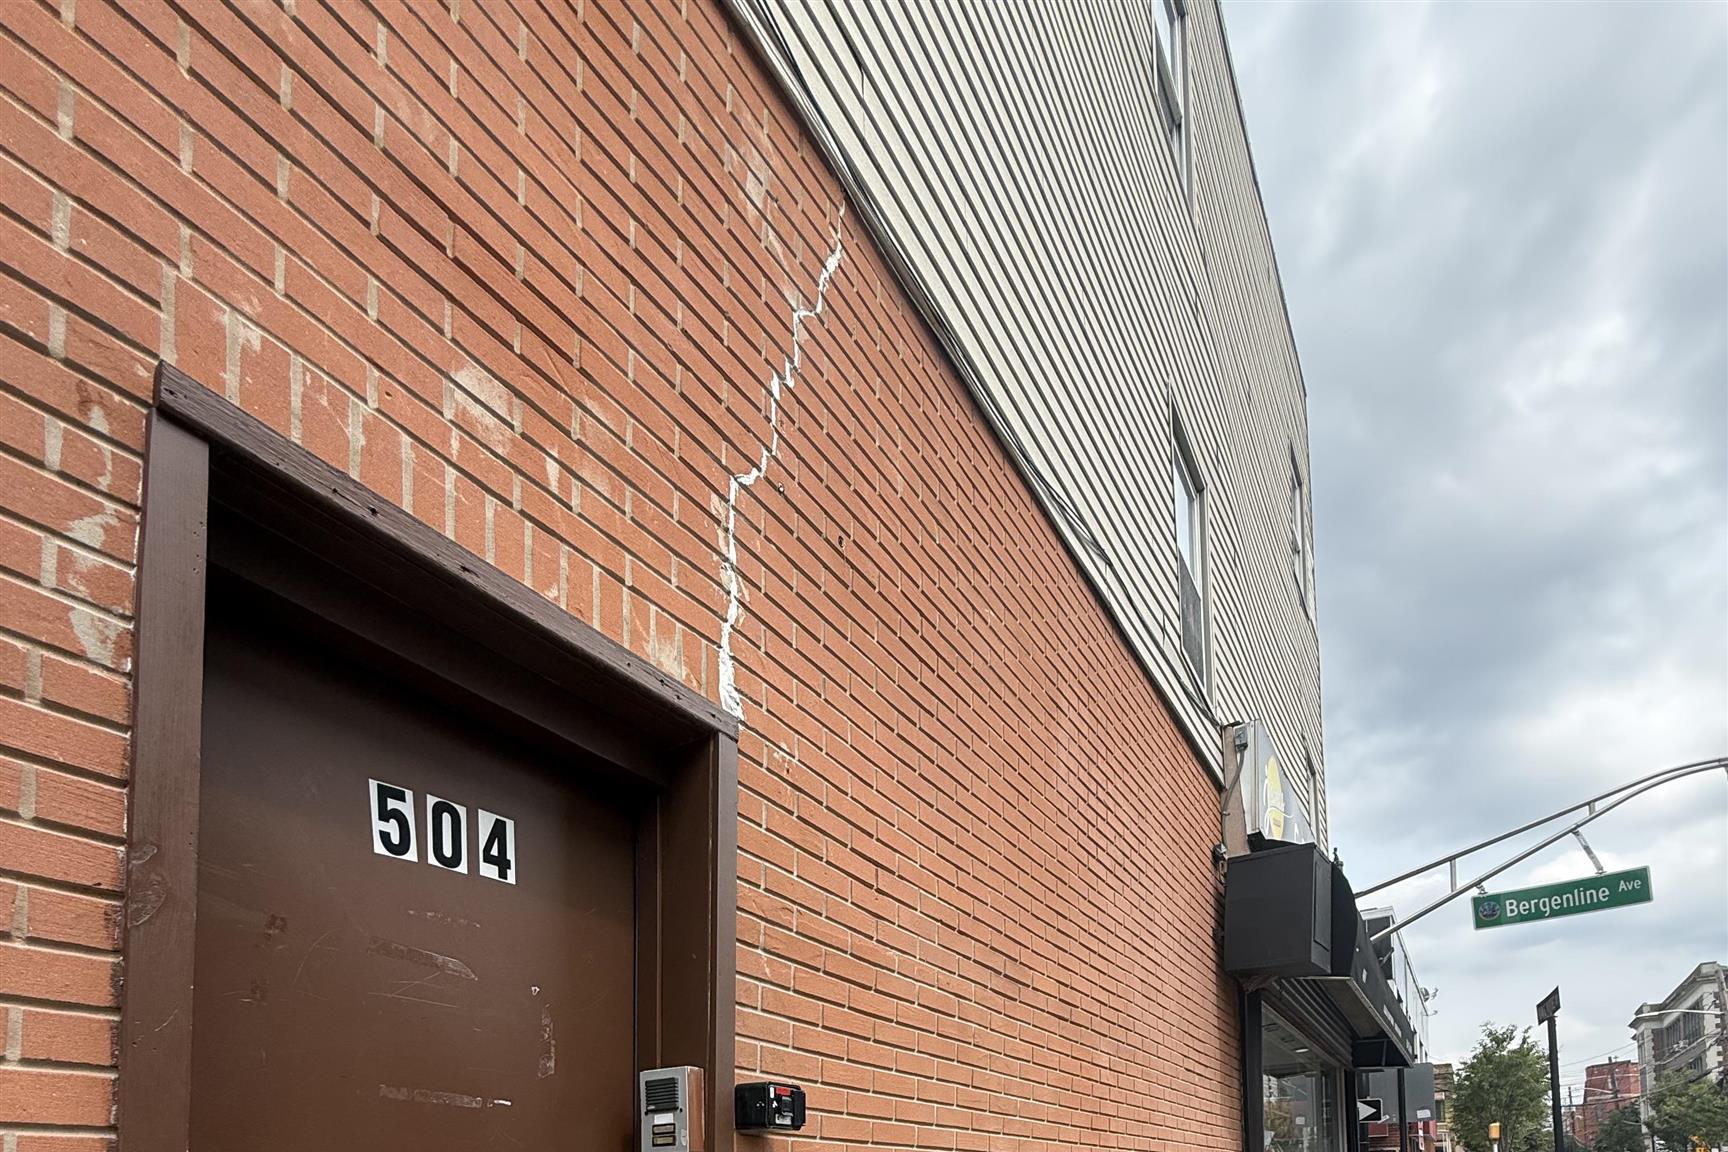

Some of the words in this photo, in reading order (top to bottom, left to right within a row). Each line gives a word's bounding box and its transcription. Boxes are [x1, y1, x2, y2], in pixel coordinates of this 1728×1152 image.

[376, 782, 512, 881] 504
[1505, 888, 1610, 917] Bergenline
[1618, 879, 1642, 893] Ave
